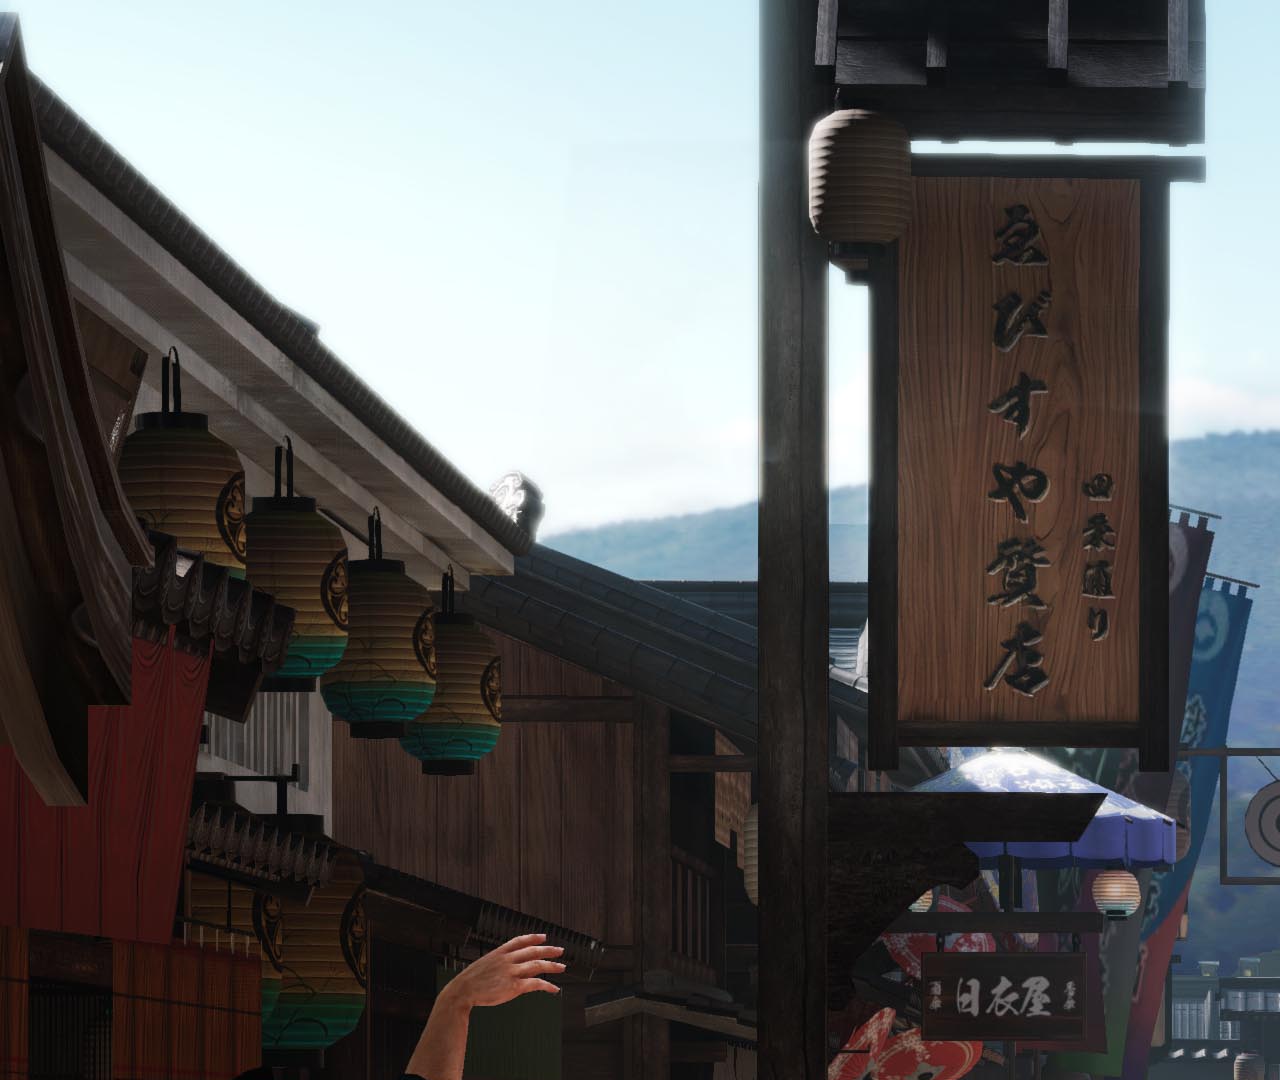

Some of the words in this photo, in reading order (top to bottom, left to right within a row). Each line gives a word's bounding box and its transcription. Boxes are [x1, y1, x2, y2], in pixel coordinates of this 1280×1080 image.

[984, 203, 1051, 698] ゑびすや質店
